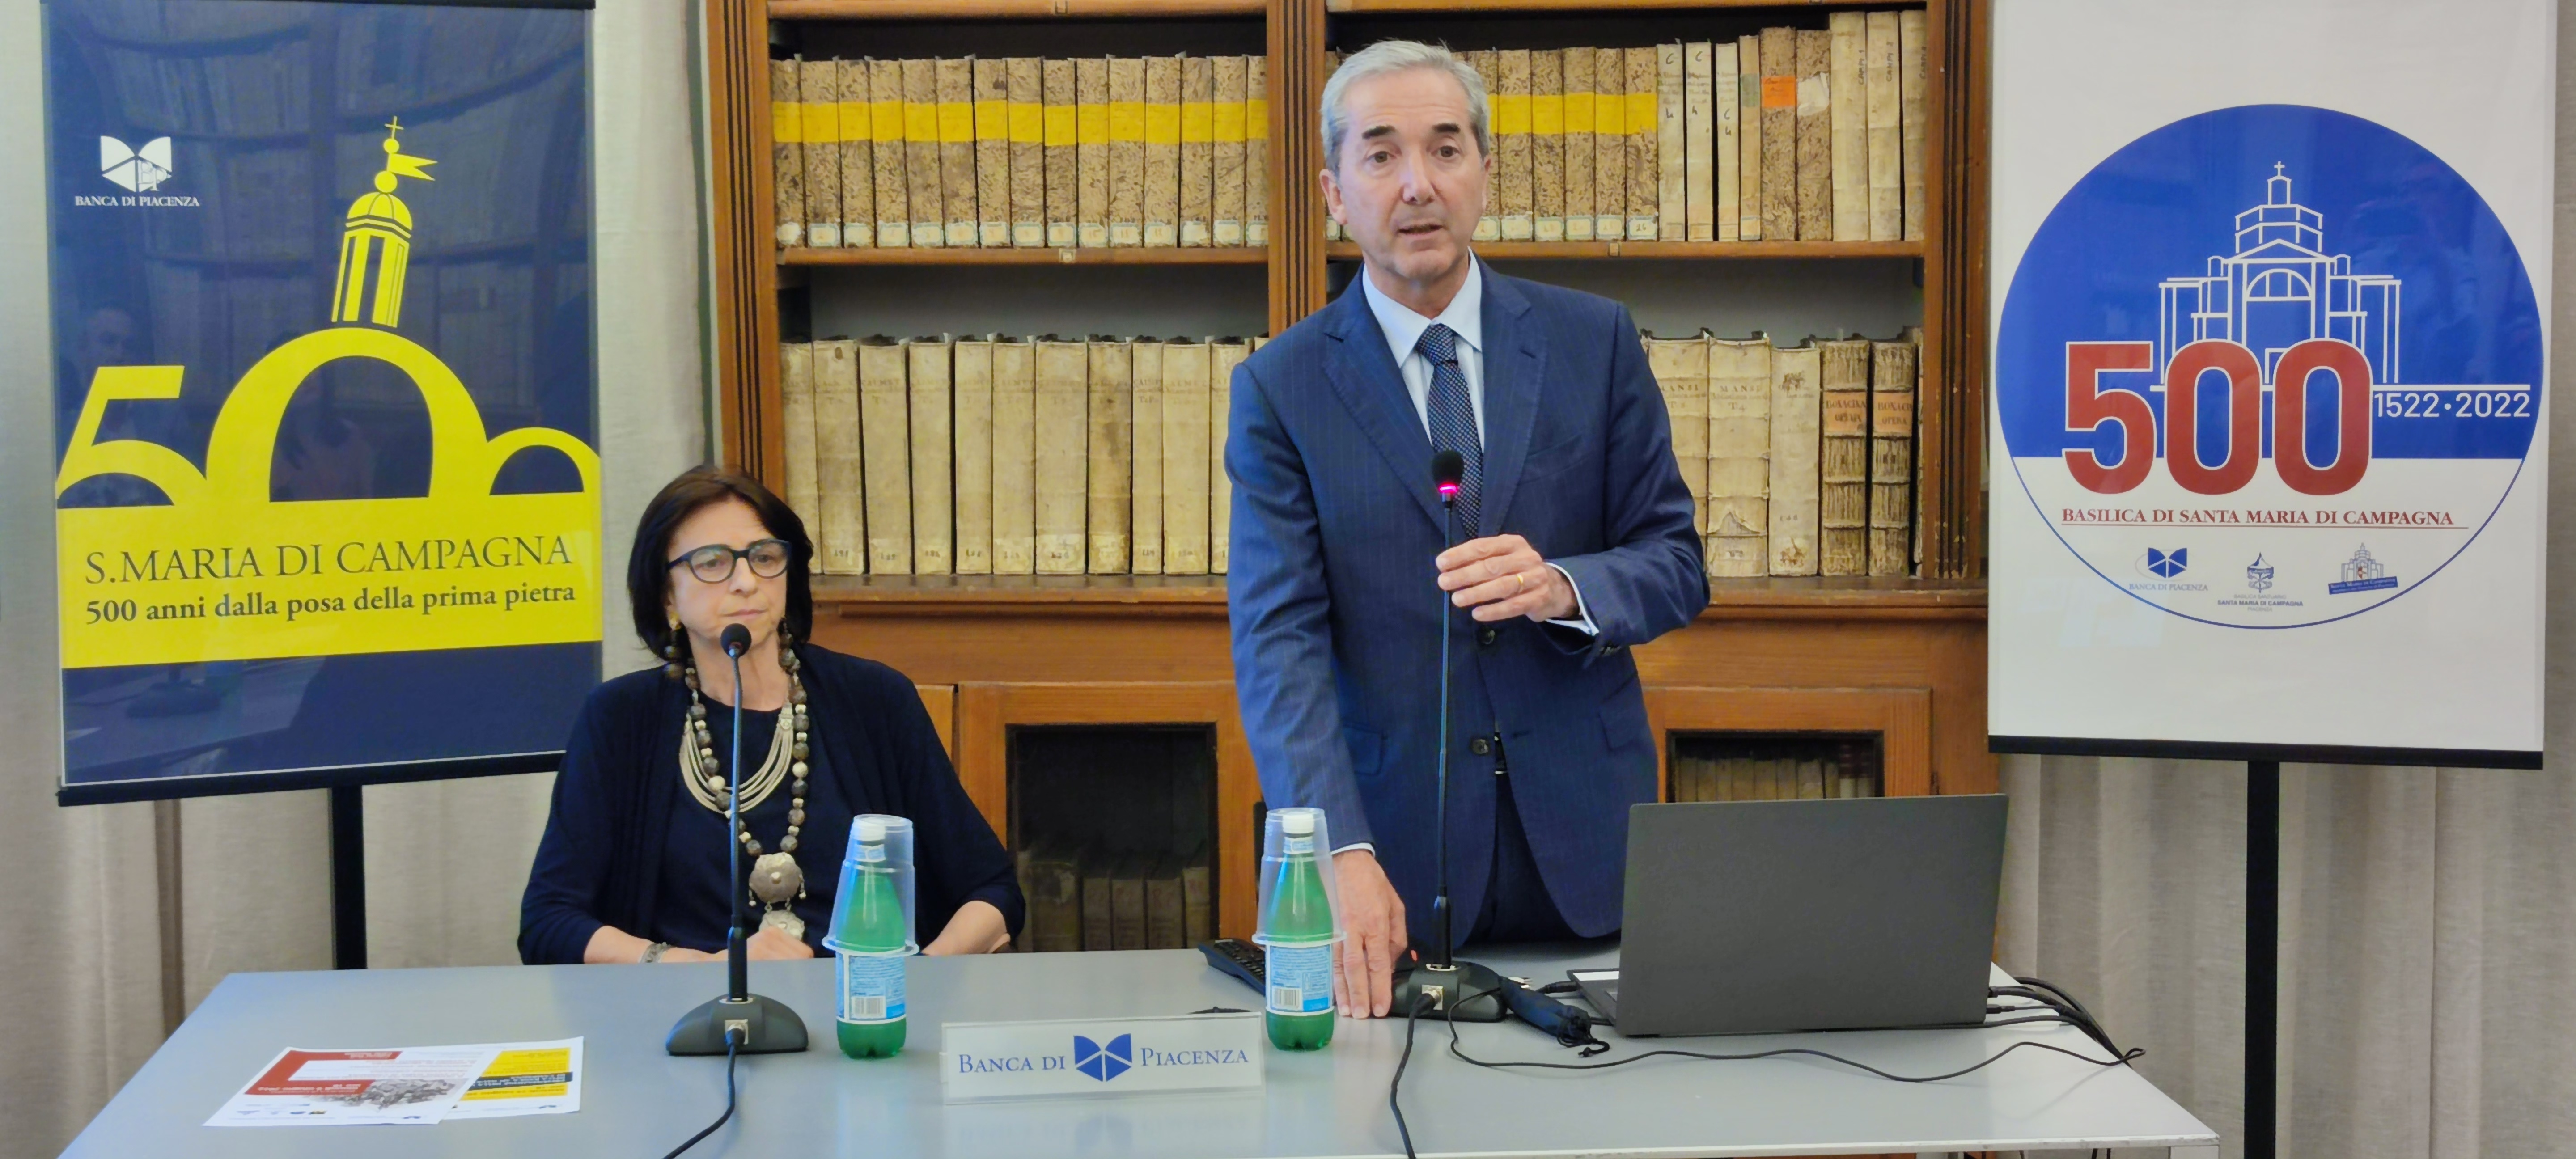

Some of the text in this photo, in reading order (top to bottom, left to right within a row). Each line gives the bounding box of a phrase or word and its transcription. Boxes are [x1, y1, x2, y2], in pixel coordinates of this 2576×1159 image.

[75, 196, 200, 207] BANCA DI PIACENZA
[2064, 338, 2373, 495] 500
[2062, 508, 2454, 525] BASILICA DI SANTA MARIA DI CAMPAGNA
[85, 535, 572, 584] S.MARIA DI CAMPAGNA
[86, 582, 576, 625] 500 anni dalla posa della prima pietra
[958, 1047, 1250, 1074] BANCA DI PIACENZA
